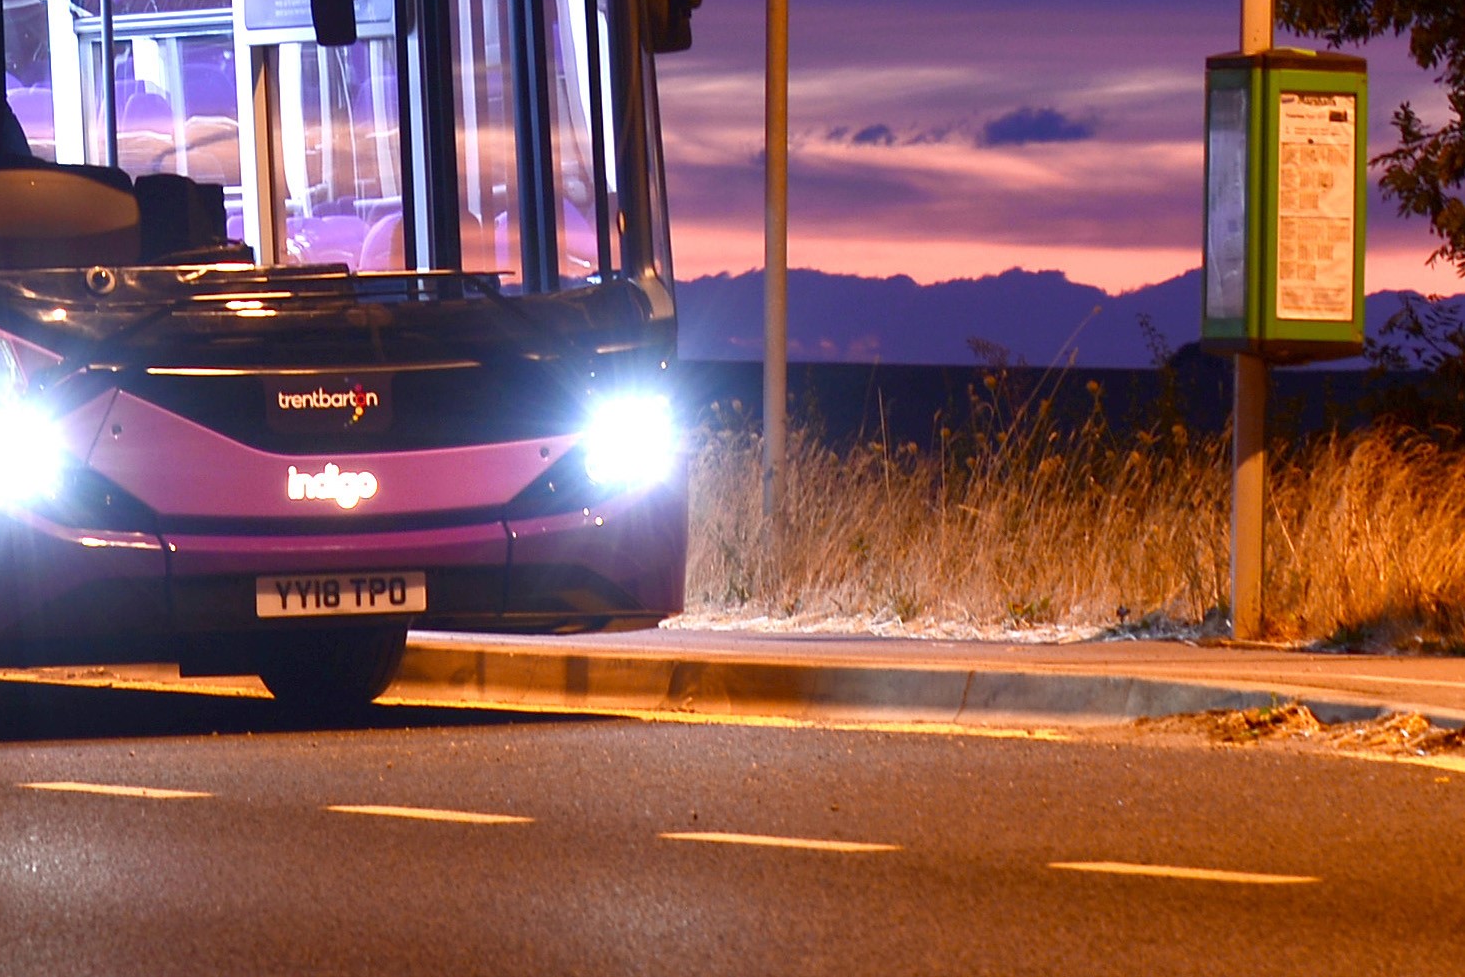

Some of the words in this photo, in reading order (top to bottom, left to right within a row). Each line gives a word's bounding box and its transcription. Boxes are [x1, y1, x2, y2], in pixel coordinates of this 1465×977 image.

[278, 387, 379, 409] trentbarton
[287, 462, 378, 509] indigo
[275, 579, 340, 610] YY18
[349, 577, 407, 607] TPO
